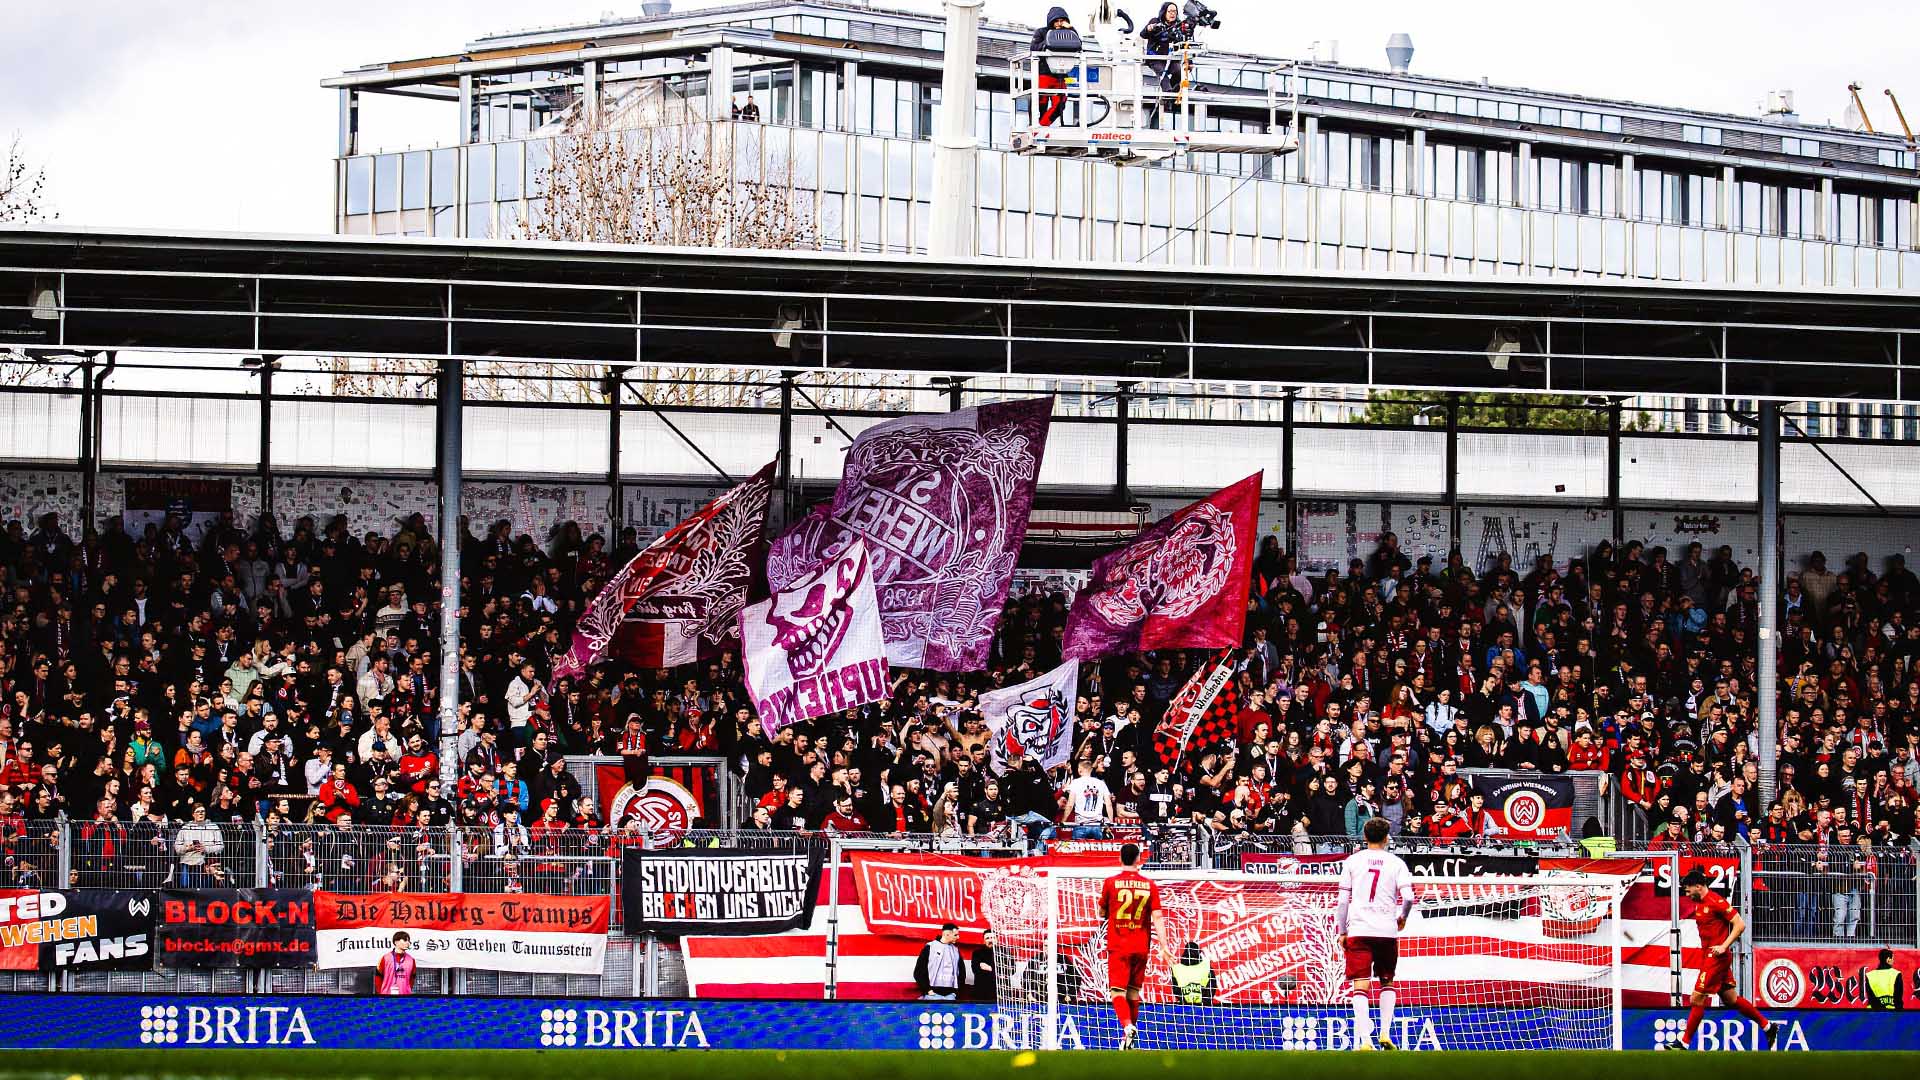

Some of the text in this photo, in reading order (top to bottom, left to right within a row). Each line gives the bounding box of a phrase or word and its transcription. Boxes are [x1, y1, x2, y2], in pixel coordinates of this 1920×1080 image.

[1091, 131, 1132, 141] mateco
[641, 859, 809, 893] STADIONVERBOTE
[1367, 868, 1381, 903] 7
[1708, 865, 1735, 889] 21
[164, 900, 309, 925] BLOCK-N
[335, 899, 379, 922] Die
[642, 893, 721, 919] BRECHEN
[724, 893, 758, 918] UNS
[875, 871, 977, 922] SUPREMUS
[1116, 888, 1151, 921] 27
[1216, 893, 1249, 926] SV
[0, 914, 97, 947] WEHEN
[163, 937, 310, 956] block-n@gmx.de
[336, 936, 393, 953] Fanclub
[426, 938, 450, 952] SV
[456, 938, 506, 955] Wehen
[512, 940, 593, 957] Taunusstein
[1201, 926, 1263, 963] WEHEN
[55, 934, 149, 966] FANS
[1776, 969, 1788, 978] SV
[1777, 993, 1788, 1001] 26
[185, 1005, 317, 1044] BRITA
[585, 1009, 710, 1047] BRITA
